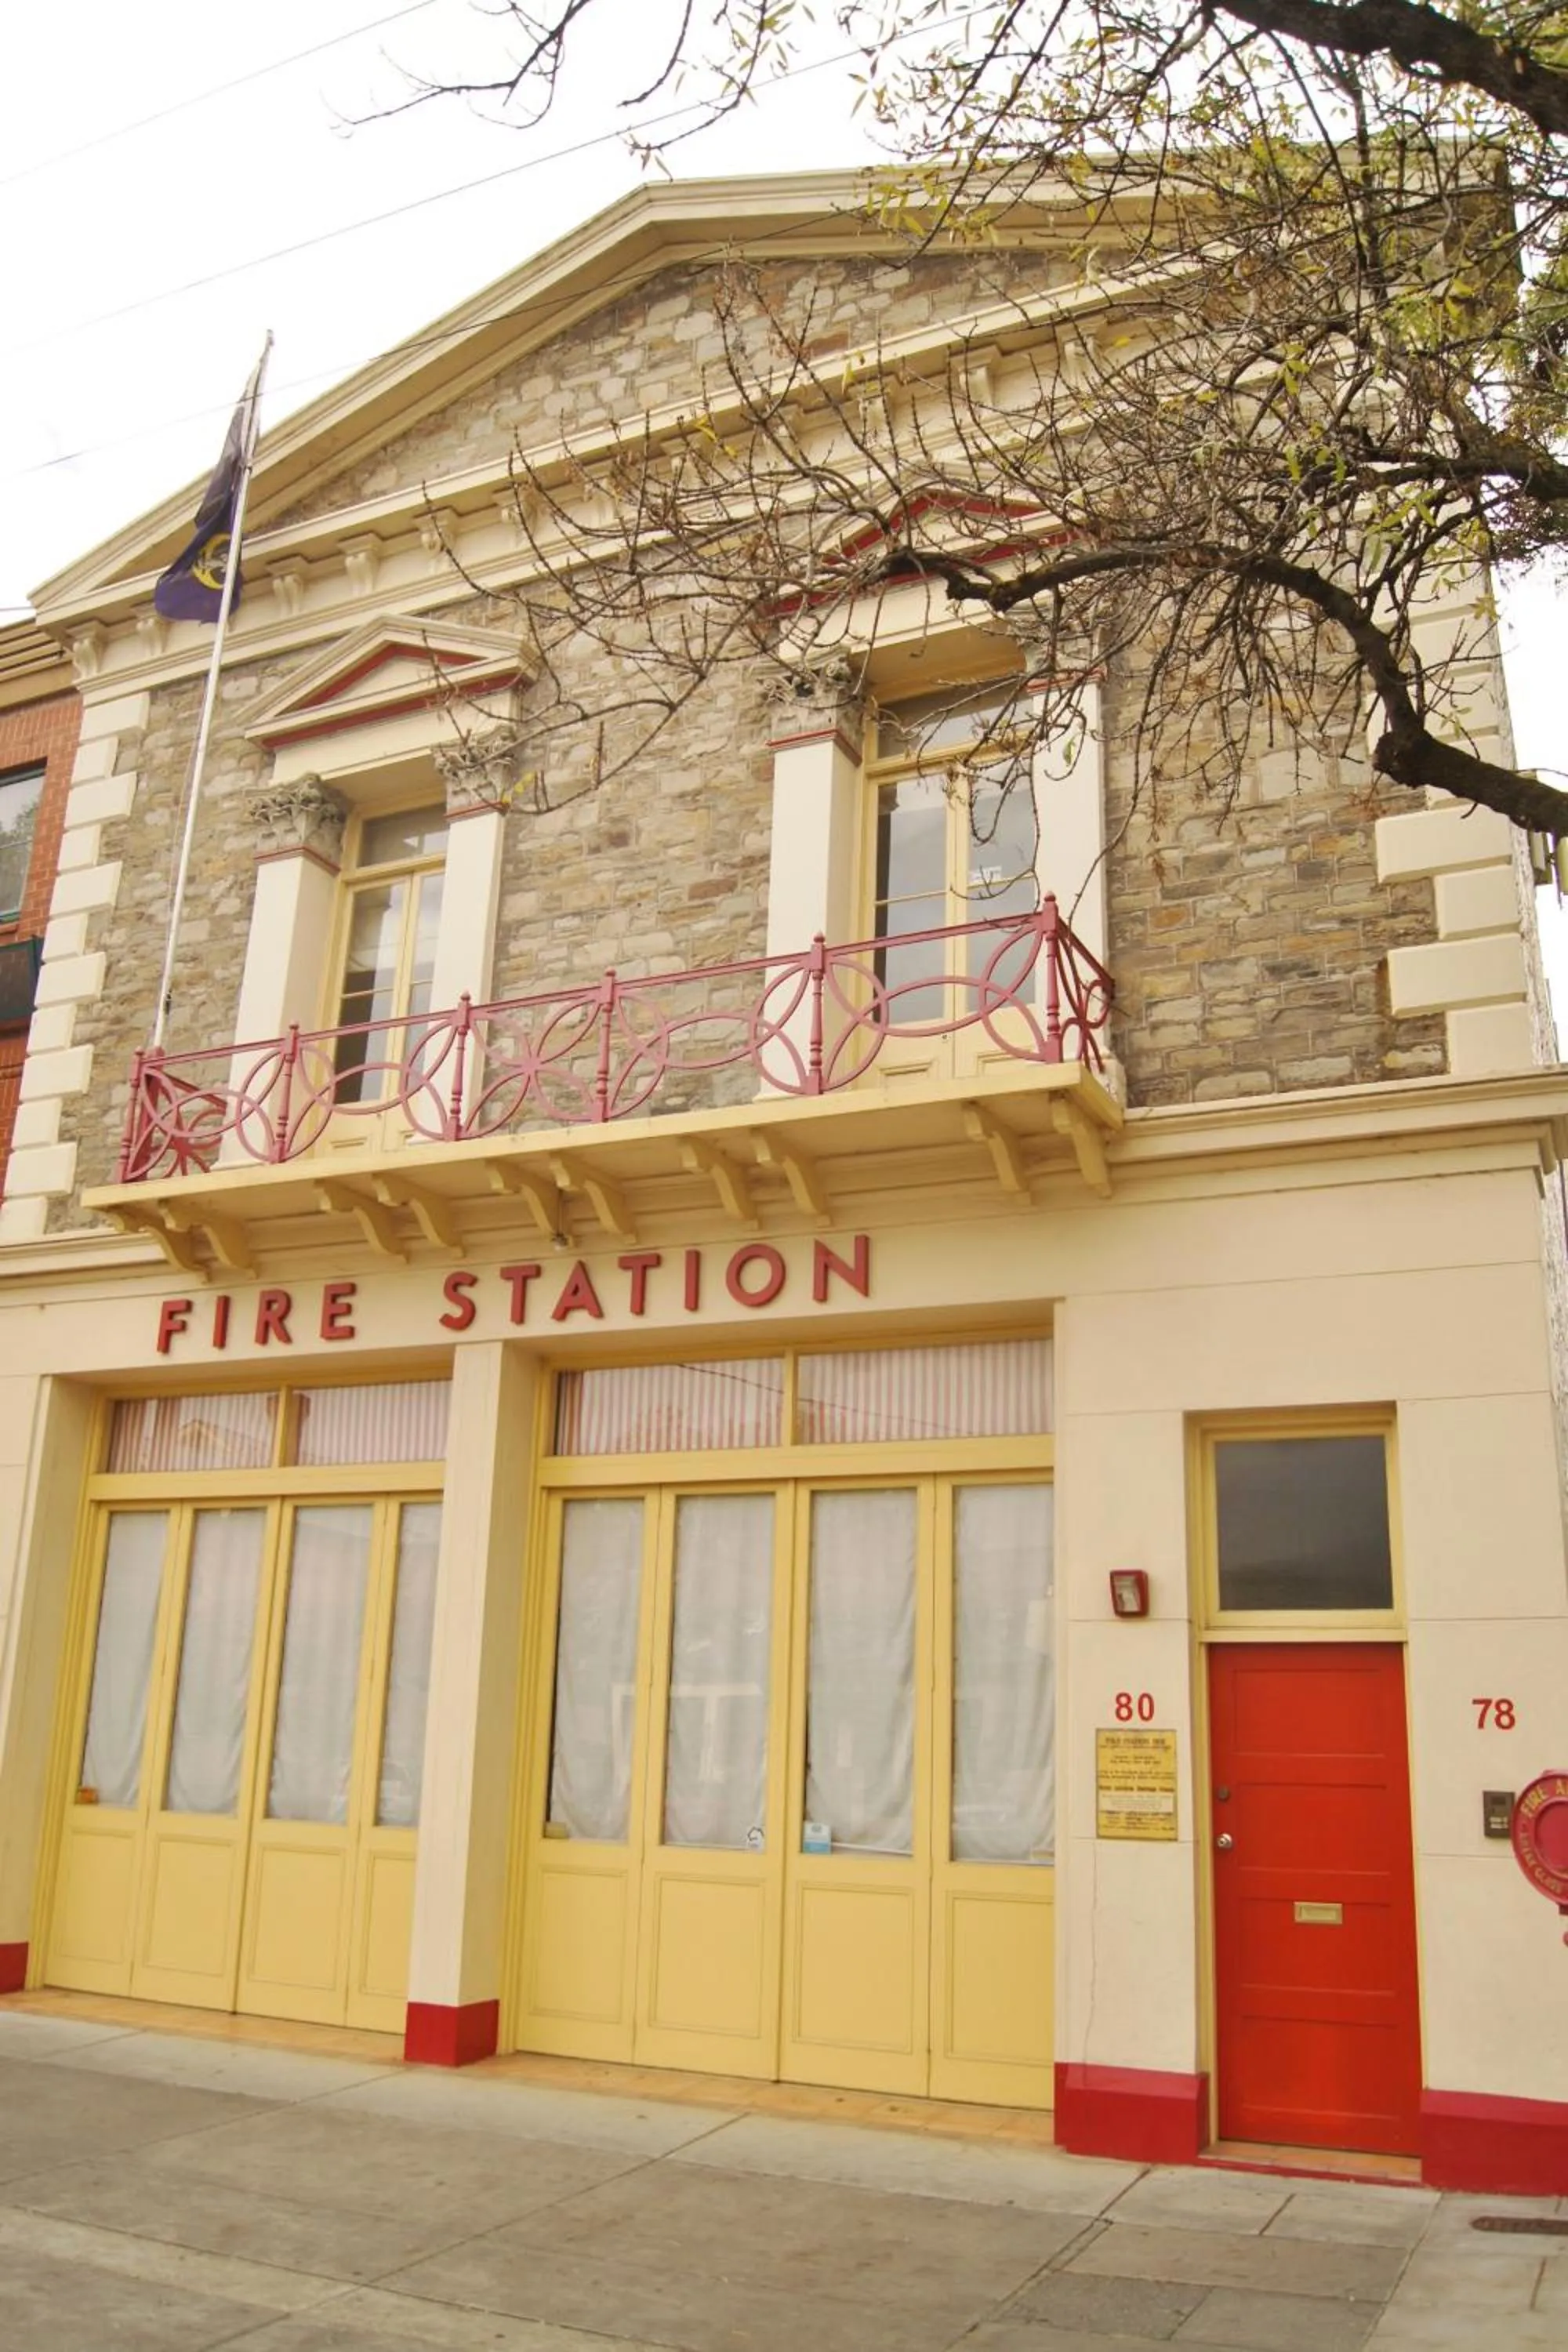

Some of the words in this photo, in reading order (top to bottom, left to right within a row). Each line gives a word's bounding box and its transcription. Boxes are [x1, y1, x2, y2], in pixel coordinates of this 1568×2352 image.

[154, 1281, 356, 1355] FIRE
[439, 1235, 870, 1331] STATION
[1115, 1691, 1156, 1722] 80
[1472, 1697, 1516, 1731] 78
[1520, 1784, 1550, 1818] FIRE
